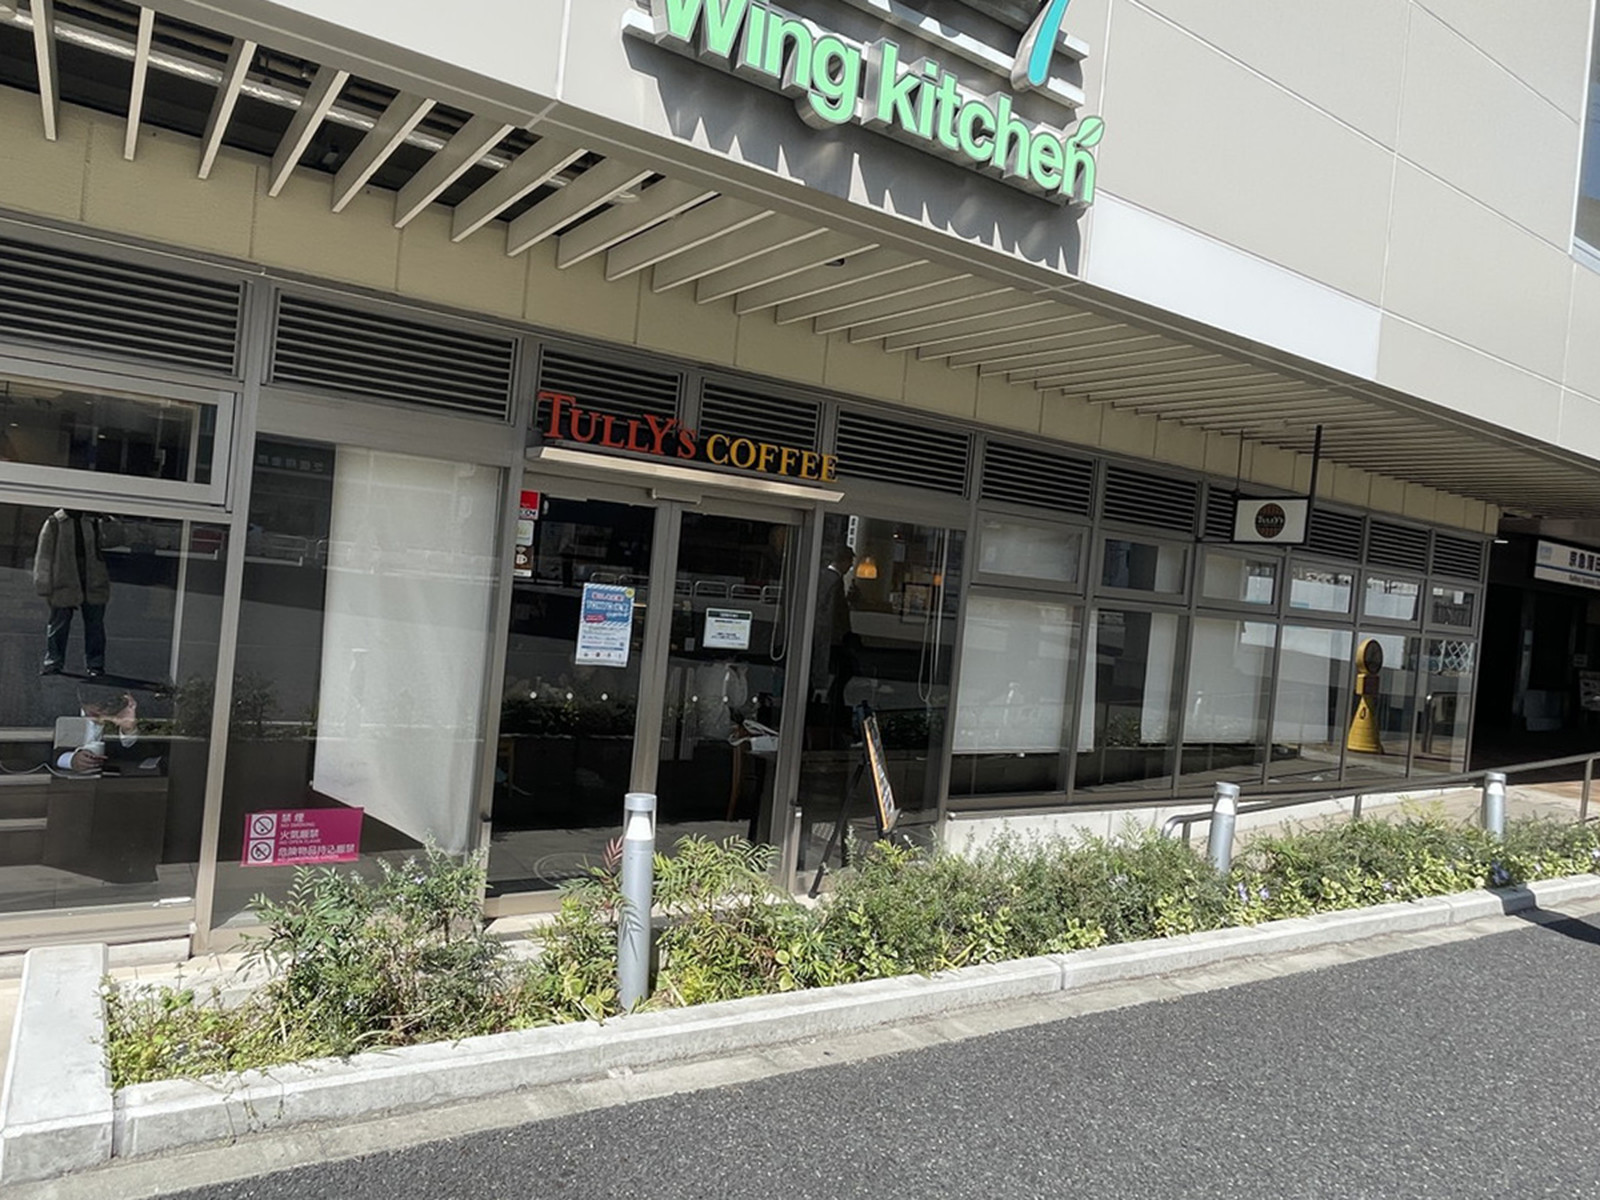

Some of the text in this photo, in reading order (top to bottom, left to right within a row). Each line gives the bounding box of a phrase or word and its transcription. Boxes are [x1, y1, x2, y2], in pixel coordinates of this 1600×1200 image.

[662, 0, 1099, 205] Wing kitchen
[706, 433, 839, 482] COFFEE
